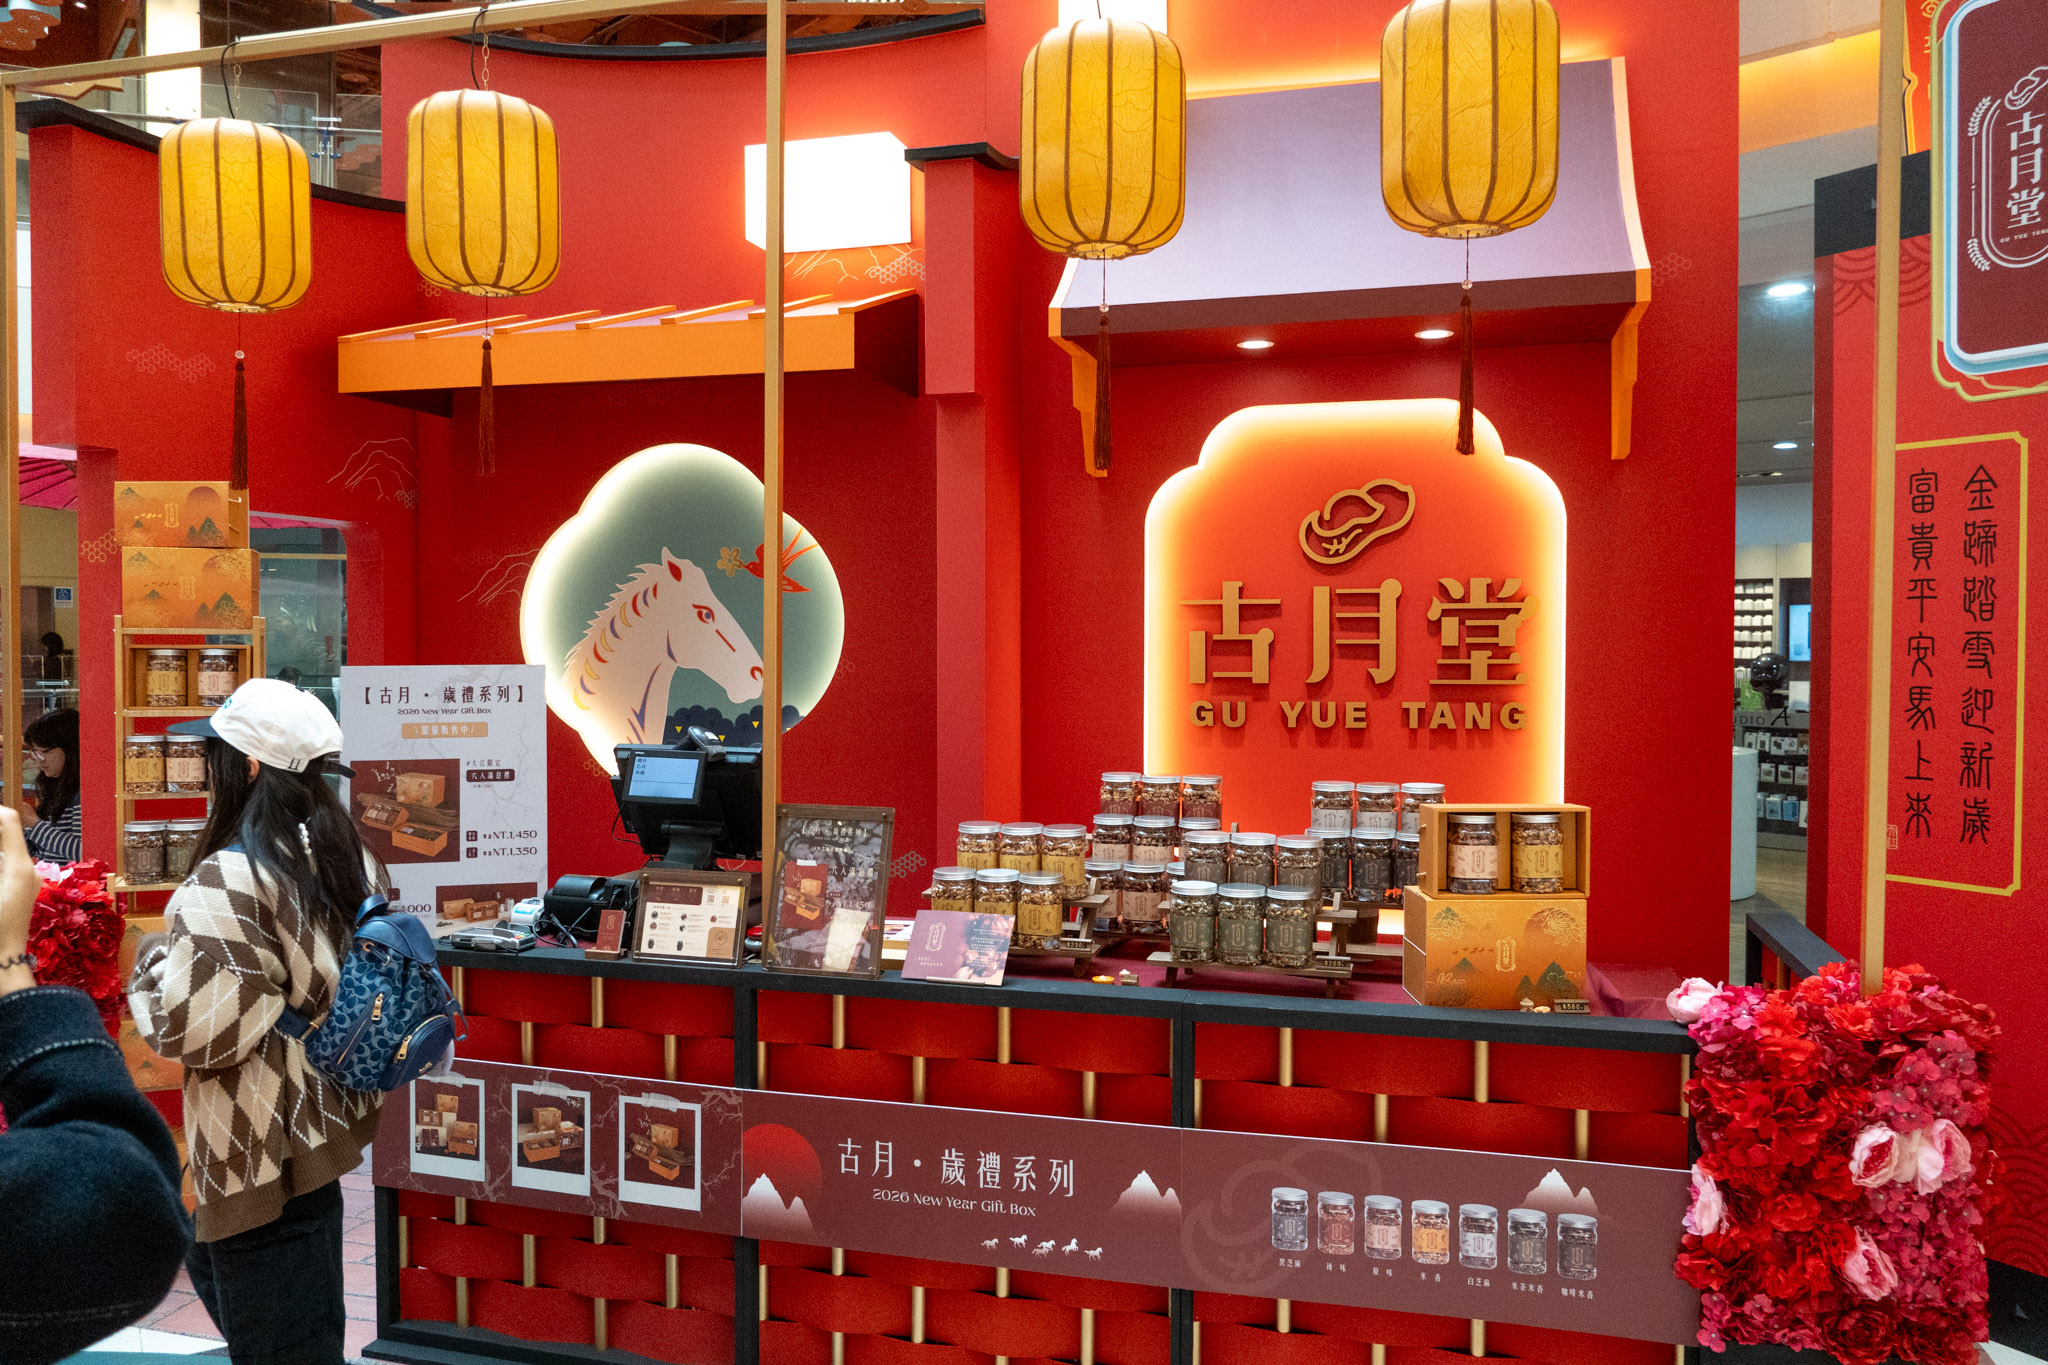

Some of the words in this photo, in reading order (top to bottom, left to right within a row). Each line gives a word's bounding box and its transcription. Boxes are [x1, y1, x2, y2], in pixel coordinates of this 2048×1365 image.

[2006, 111, 2046, 229] 古月堂
[1179, 577, 1541, 685] 古月堂
[1904, 467, 1939, 839] 富貴平安馬上來
[397, 708, 420, 716] 2026
[421, 707, 440, 715] New
[440, 707, 458, 715] Year
[460, 706, 475, 715] Gift
[477, 706, 492, 715] Box
[1188, 700, 1247, 728] GU
[1280, 701, 1368, 729] YUE
[1401, 701, 1528, 730] TANG
[1734, 715, 1766, 726] DIO
[872, 1188, 910, 1203] 2026
[913, 1192, 943, 1207] New
[945, 1196, 977, 1211] Year
[981, 1200, 1007, 1214] Gift
[1010, 1203, 1037, 1217] Box
